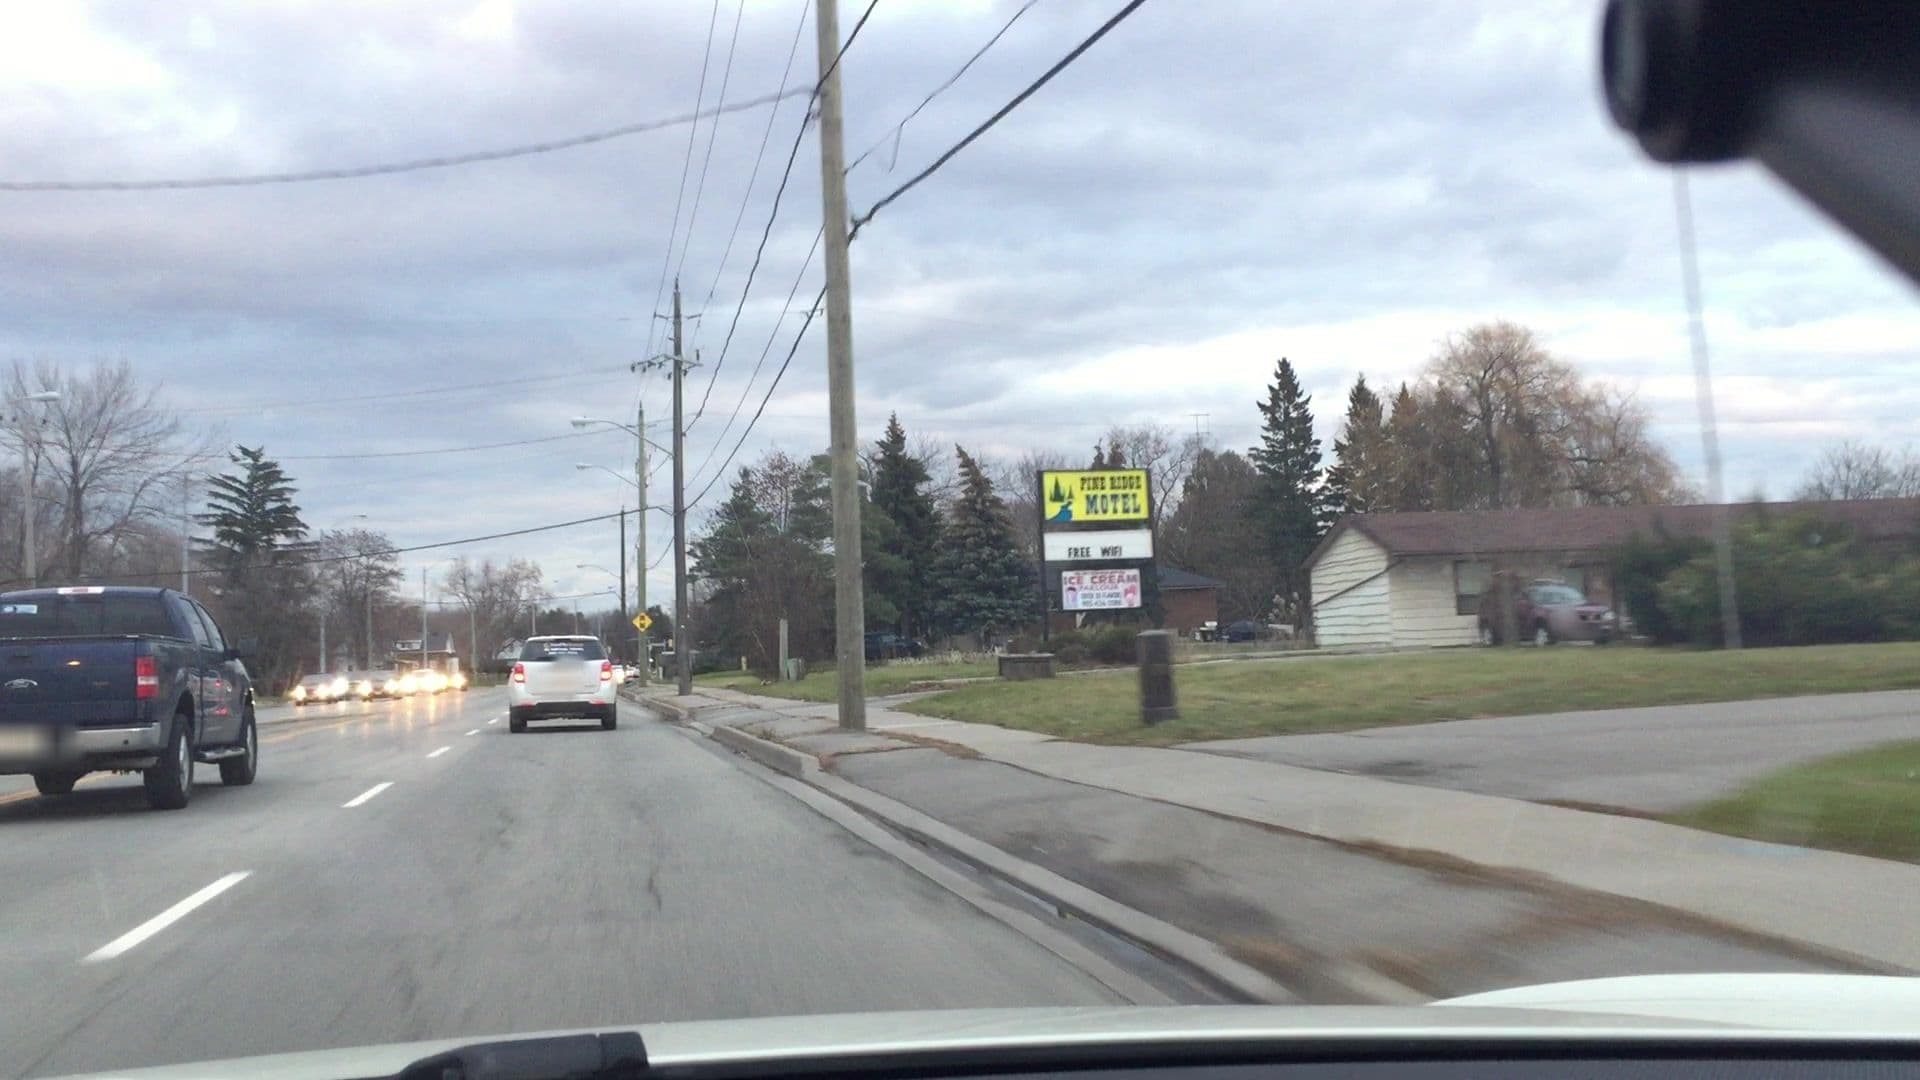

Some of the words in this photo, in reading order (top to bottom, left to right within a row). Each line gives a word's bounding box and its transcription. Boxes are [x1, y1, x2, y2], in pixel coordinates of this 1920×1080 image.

[1080, 476, 1106, 491] PINE
[1110, 475, 1142, 490] RIDGE
[1086, 494, 1140, 515] MOTEL
[1067, 547, 1091, 558] FREE
[1101, 545, 1122, 557] WIFI
[1063, 576, 1084, 585] ICE
[1090, 574, 1138, 584] CREAM
